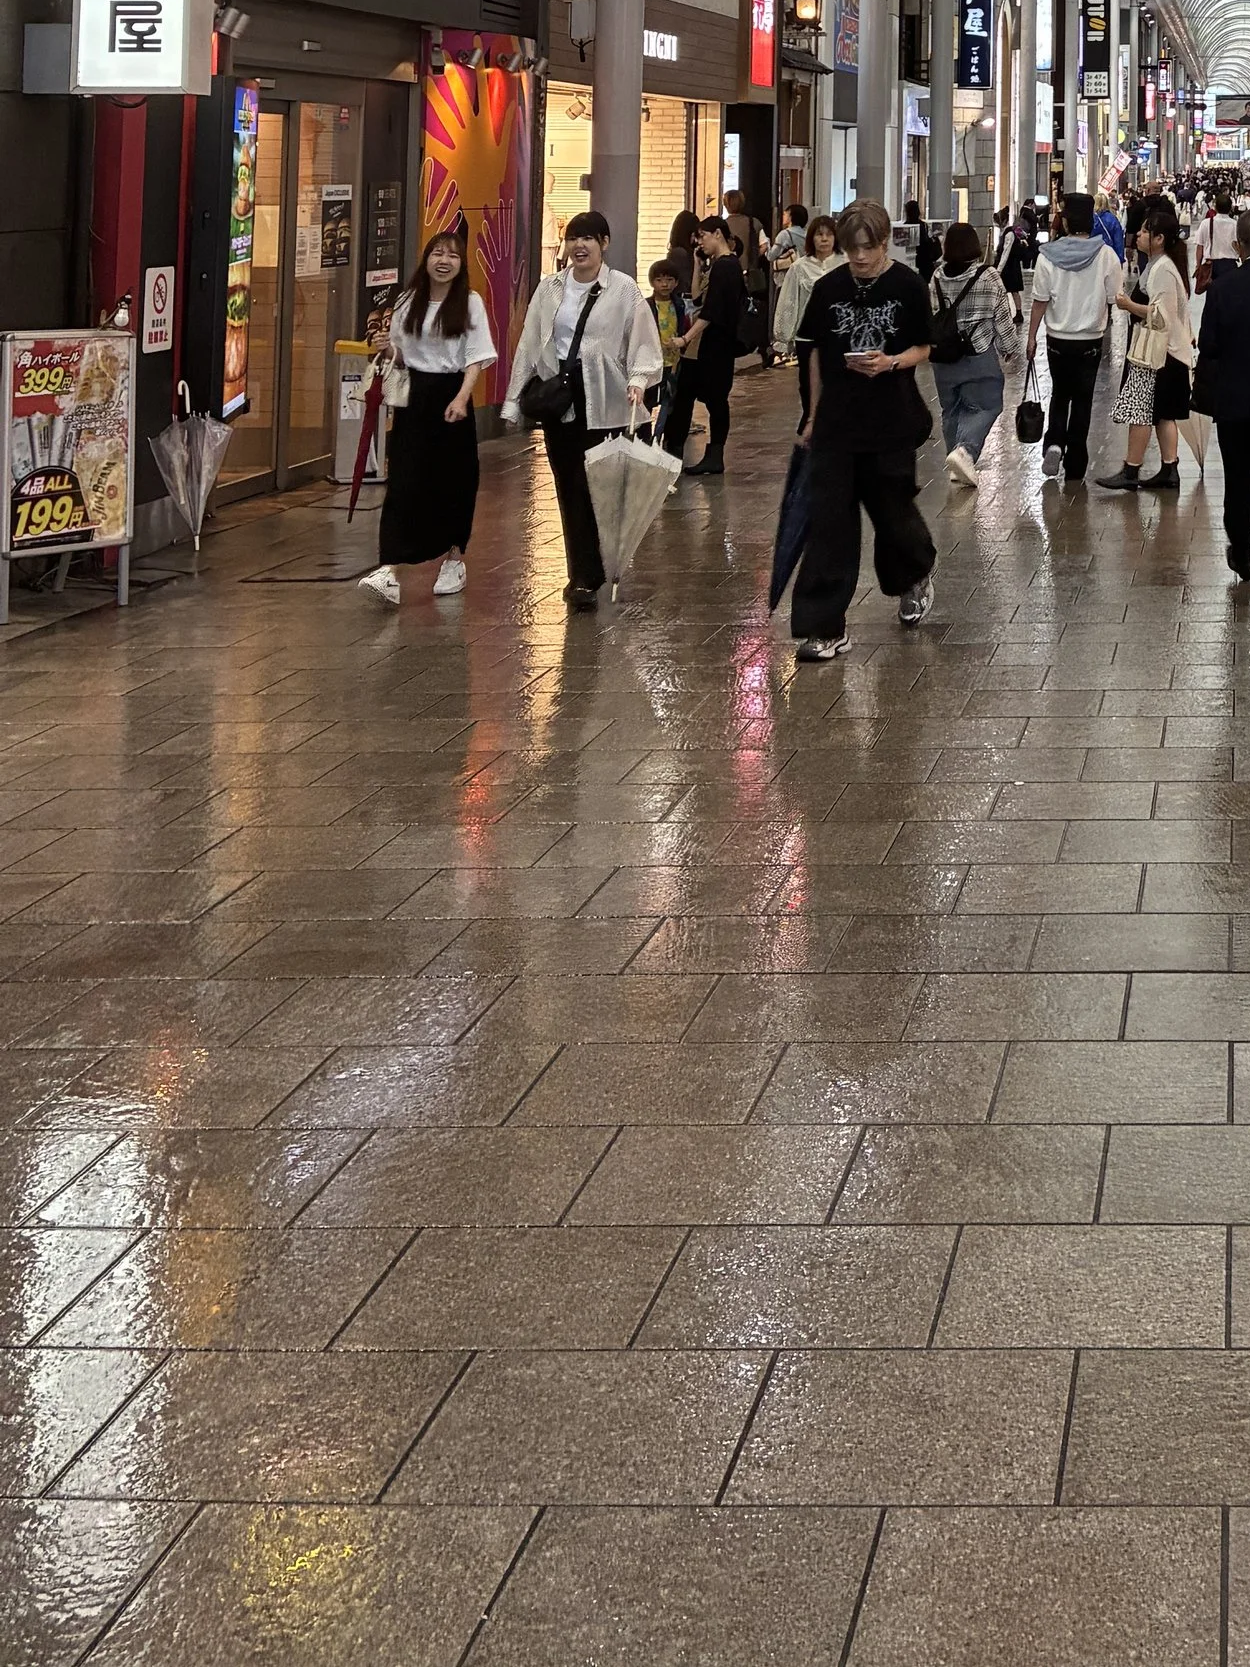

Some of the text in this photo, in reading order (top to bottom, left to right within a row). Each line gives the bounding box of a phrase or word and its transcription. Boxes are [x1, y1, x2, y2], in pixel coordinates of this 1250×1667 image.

[642, 28, 678, 62] INGNI
[17, 350, 81, 369] 角ハイボール
[19, 366, 74, 395] 399円
[15, 495, 84, 539] 199円
